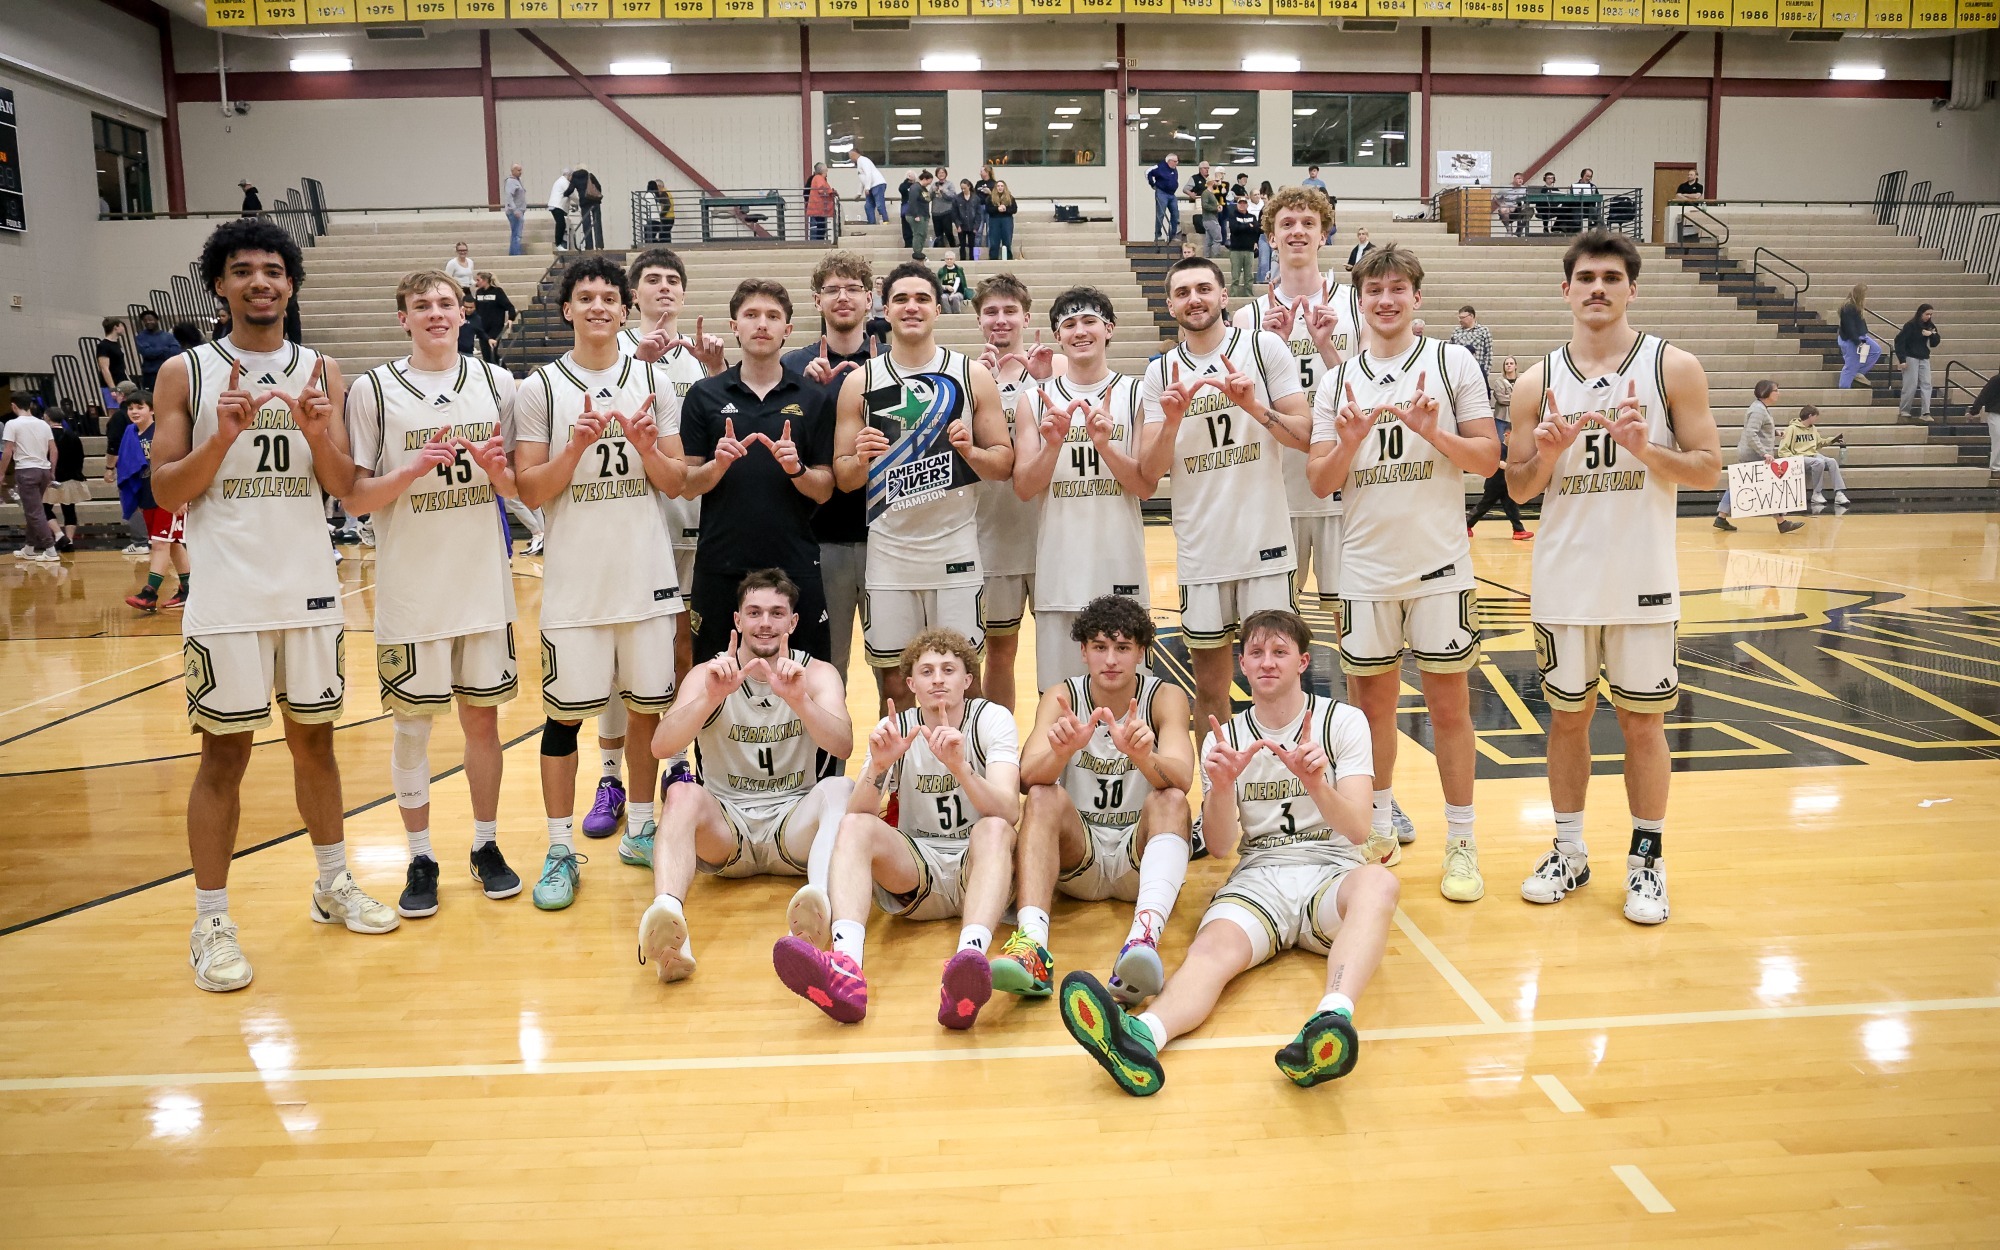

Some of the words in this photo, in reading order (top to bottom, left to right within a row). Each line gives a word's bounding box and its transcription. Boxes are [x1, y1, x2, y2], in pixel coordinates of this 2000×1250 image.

[416, 3, 445, 13] 1975
[466, 2, 495, 12] 1976
[570, 2, 598, 11] 1977
[622, 2, 650, 11] 1977
[674, 2, 703, 11] 1978
[725, 1, 754, 10] 1978
[829, 1, 857, 10] 1979
[878, 0, 909, 9] 1980
[928, 0, 959, 8] 1980
[1276, 0, 1315, 8] 1983-84
[1328, 0, 1358, 9] 1984
[1377, 1, 1406, 9] 1984
[1464, 1, 1503, 11] 1984-85
[1516, 3, 1544, 13] 1985
[216, 9, 245, 19] 1972
[266, 8, 296, 18] 1973
[366, 5, 395, 15] 1975
[1561, 5, 1589, 15] 1985
[1651, 9, 1680, 18] 1986
[1696, 10, 1724, 19] 1986
[1740, 10, 1769, 20] 1986
[1875, 13, 1903, 22] 1988
[1919, 13, 1947, 22] 1988
[1959, 12, 1997, 21] 1988-89
[1300, 358, 1314, 388] 5
[1205, 413, 1236, 449] 12
[1377, 424, 1404, 462] 10
[253, 434, 290, 472] 20
[1585, 432, 1617, 470] 50
[596, 441, 629, 478] 23
[1071, 446, 1100, 477] 44
[1184, 441, 1261, 474] WESLEYAN
[436, 448, 473, 486] 45
[887, 453, 951, 480] AMERICAN
[1737, 464, 1765, 485] WE
[888, 465, 951, 503] RIVERS
[905, 478, 951, 496] CONFERENCE
[1558, 470, 1645, 496] WESLEYAN
[1052, 479, 1122, 498] WESLEYAN
[1736, 477, 1804, 512] GWYN!
[890, 488, 948, 512] CHAMPION
[728, 718, 803, 744] NEBRASKA
[758, 747, 775, 777] 4
[727, 769, 806, 793] WESLEYAN
[1093, 778, 1123, 810] 30
[936, 794, 969, 831] 51
[1279, 802, 1296, 836] 3
